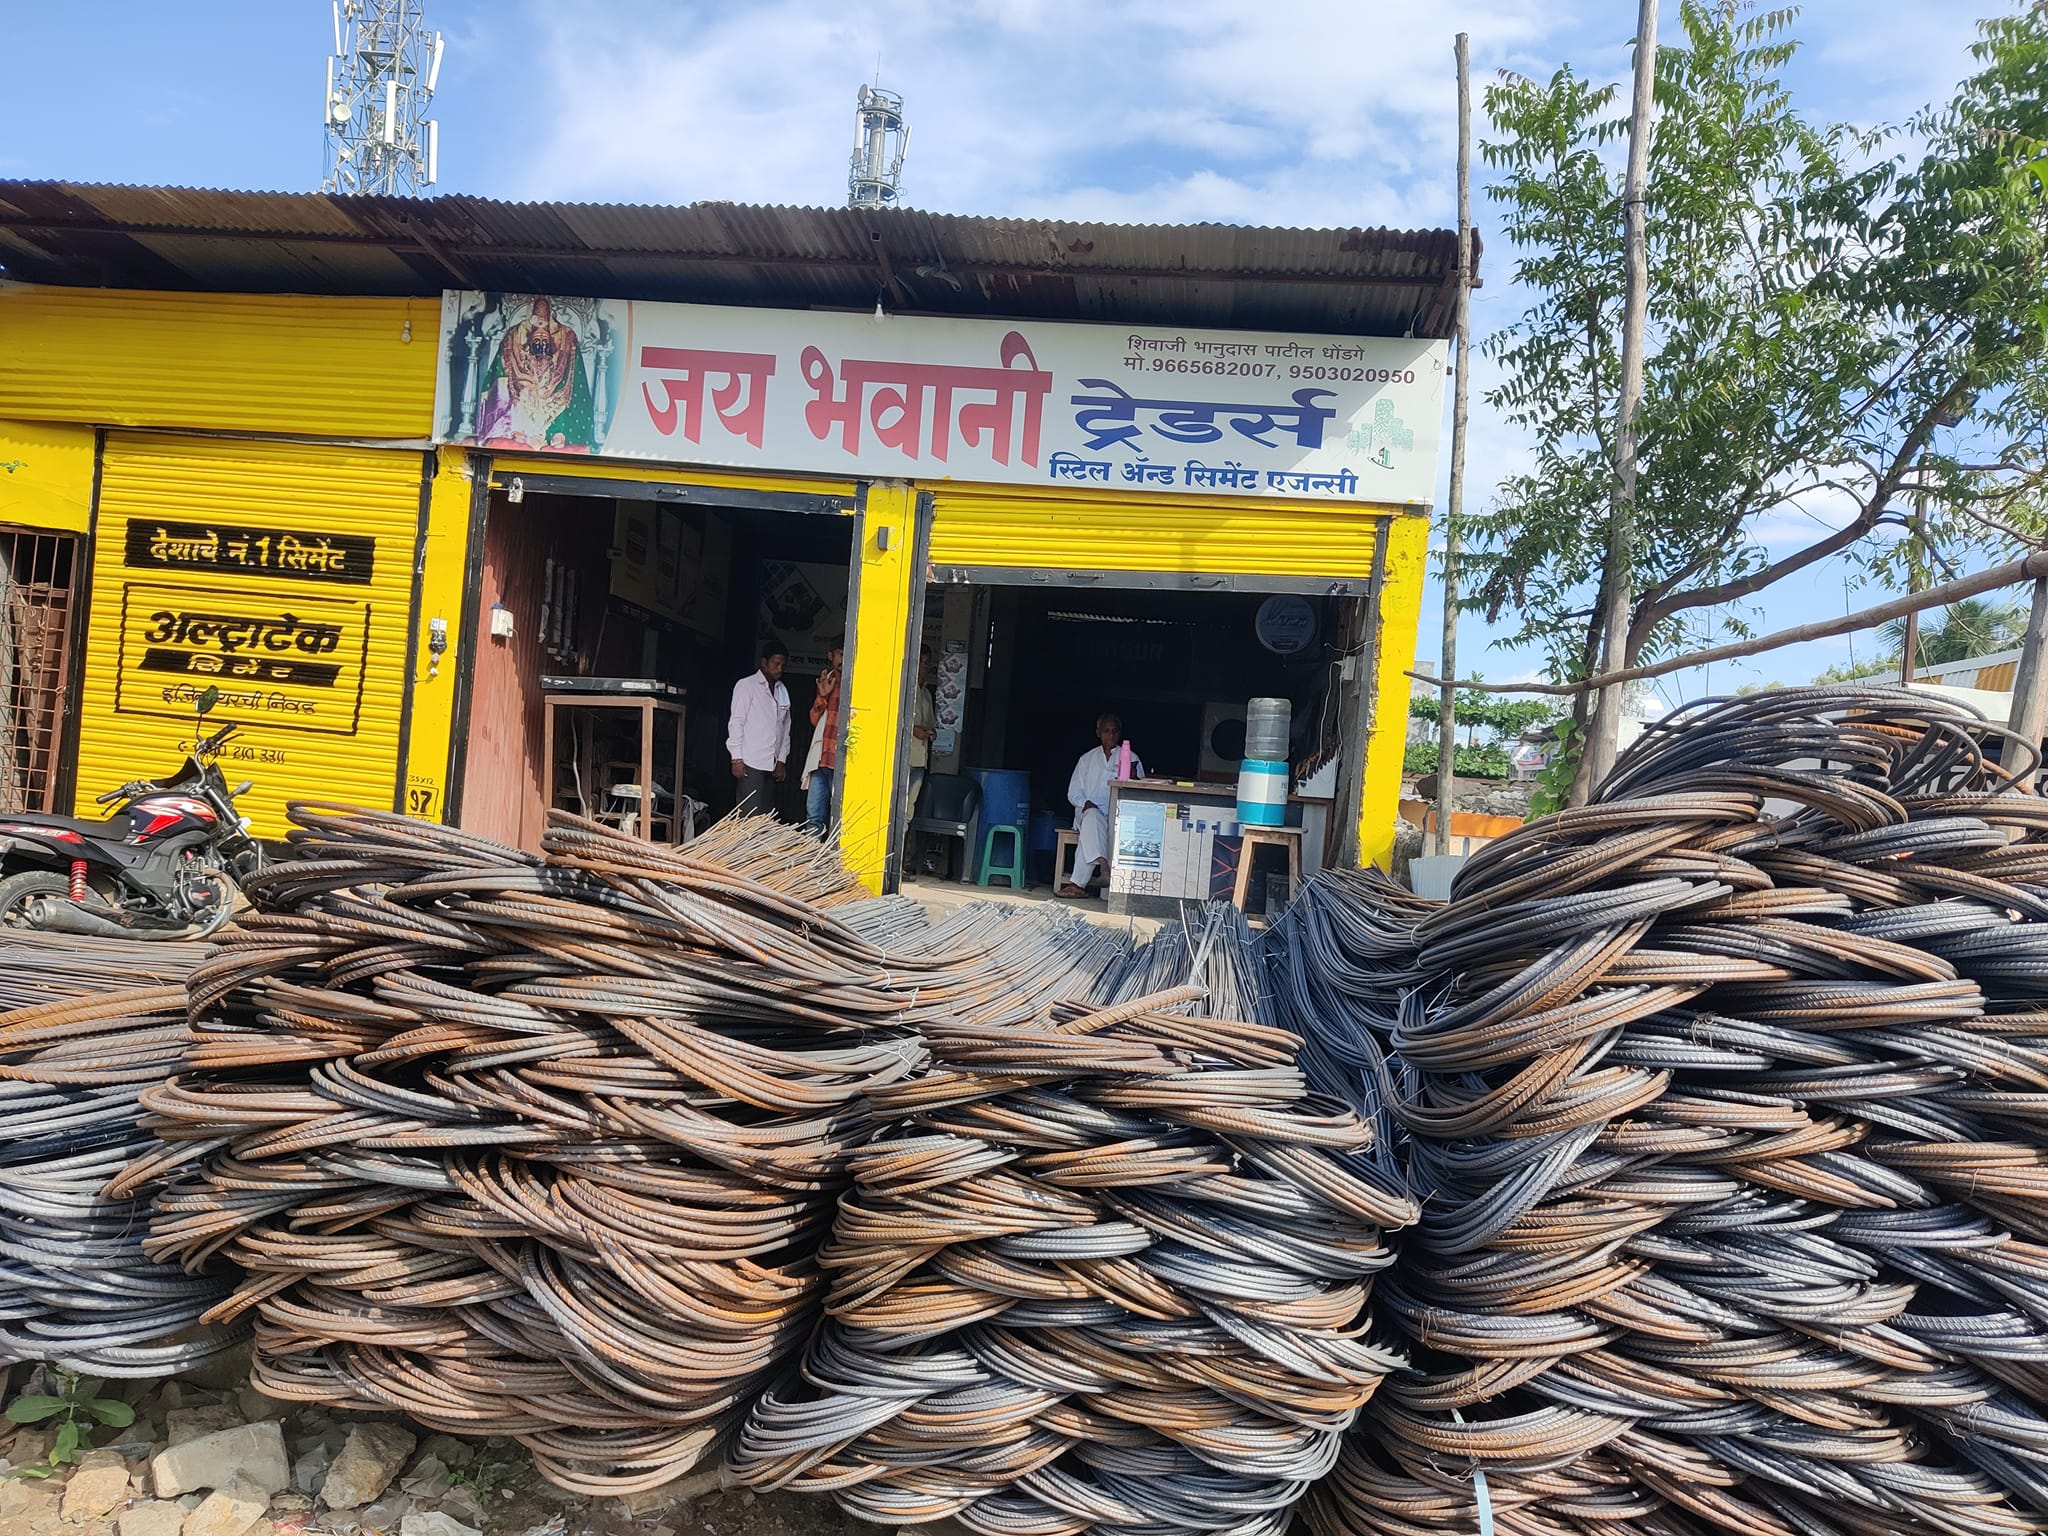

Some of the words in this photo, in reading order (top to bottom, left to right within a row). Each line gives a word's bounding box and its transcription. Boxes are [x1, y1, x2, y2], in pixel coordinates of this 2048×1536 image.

[1128, 335, 1187, 352] शिवाजी
[1194, 341, 1258, 359] भानुदास
[1265, 342, 1315, 358] पाटील
[1322, 344, 1366, 361] धोंडगे
[1289, 365, 1415, 384] 9503020950
[641, 346, 776, 449] जय
[801, 331, 1053, 469] भवानी
[1071, 378, 1338, 453] ट्रेडर्स
[1049, 451, 1112, 481] स्टिल
[1184, 460, 1259, 489] सिमेंट
[1267, 468, 1359, 494] एजन्सी
[277, 535, 346, 571] सिमेंट
[144, 611, 344, 654] अल्ट्राटेक
[267, 692, 318, 714] निवड
[261, 749, 286, 764] 3311
[410, 789, 432, 813] 97
